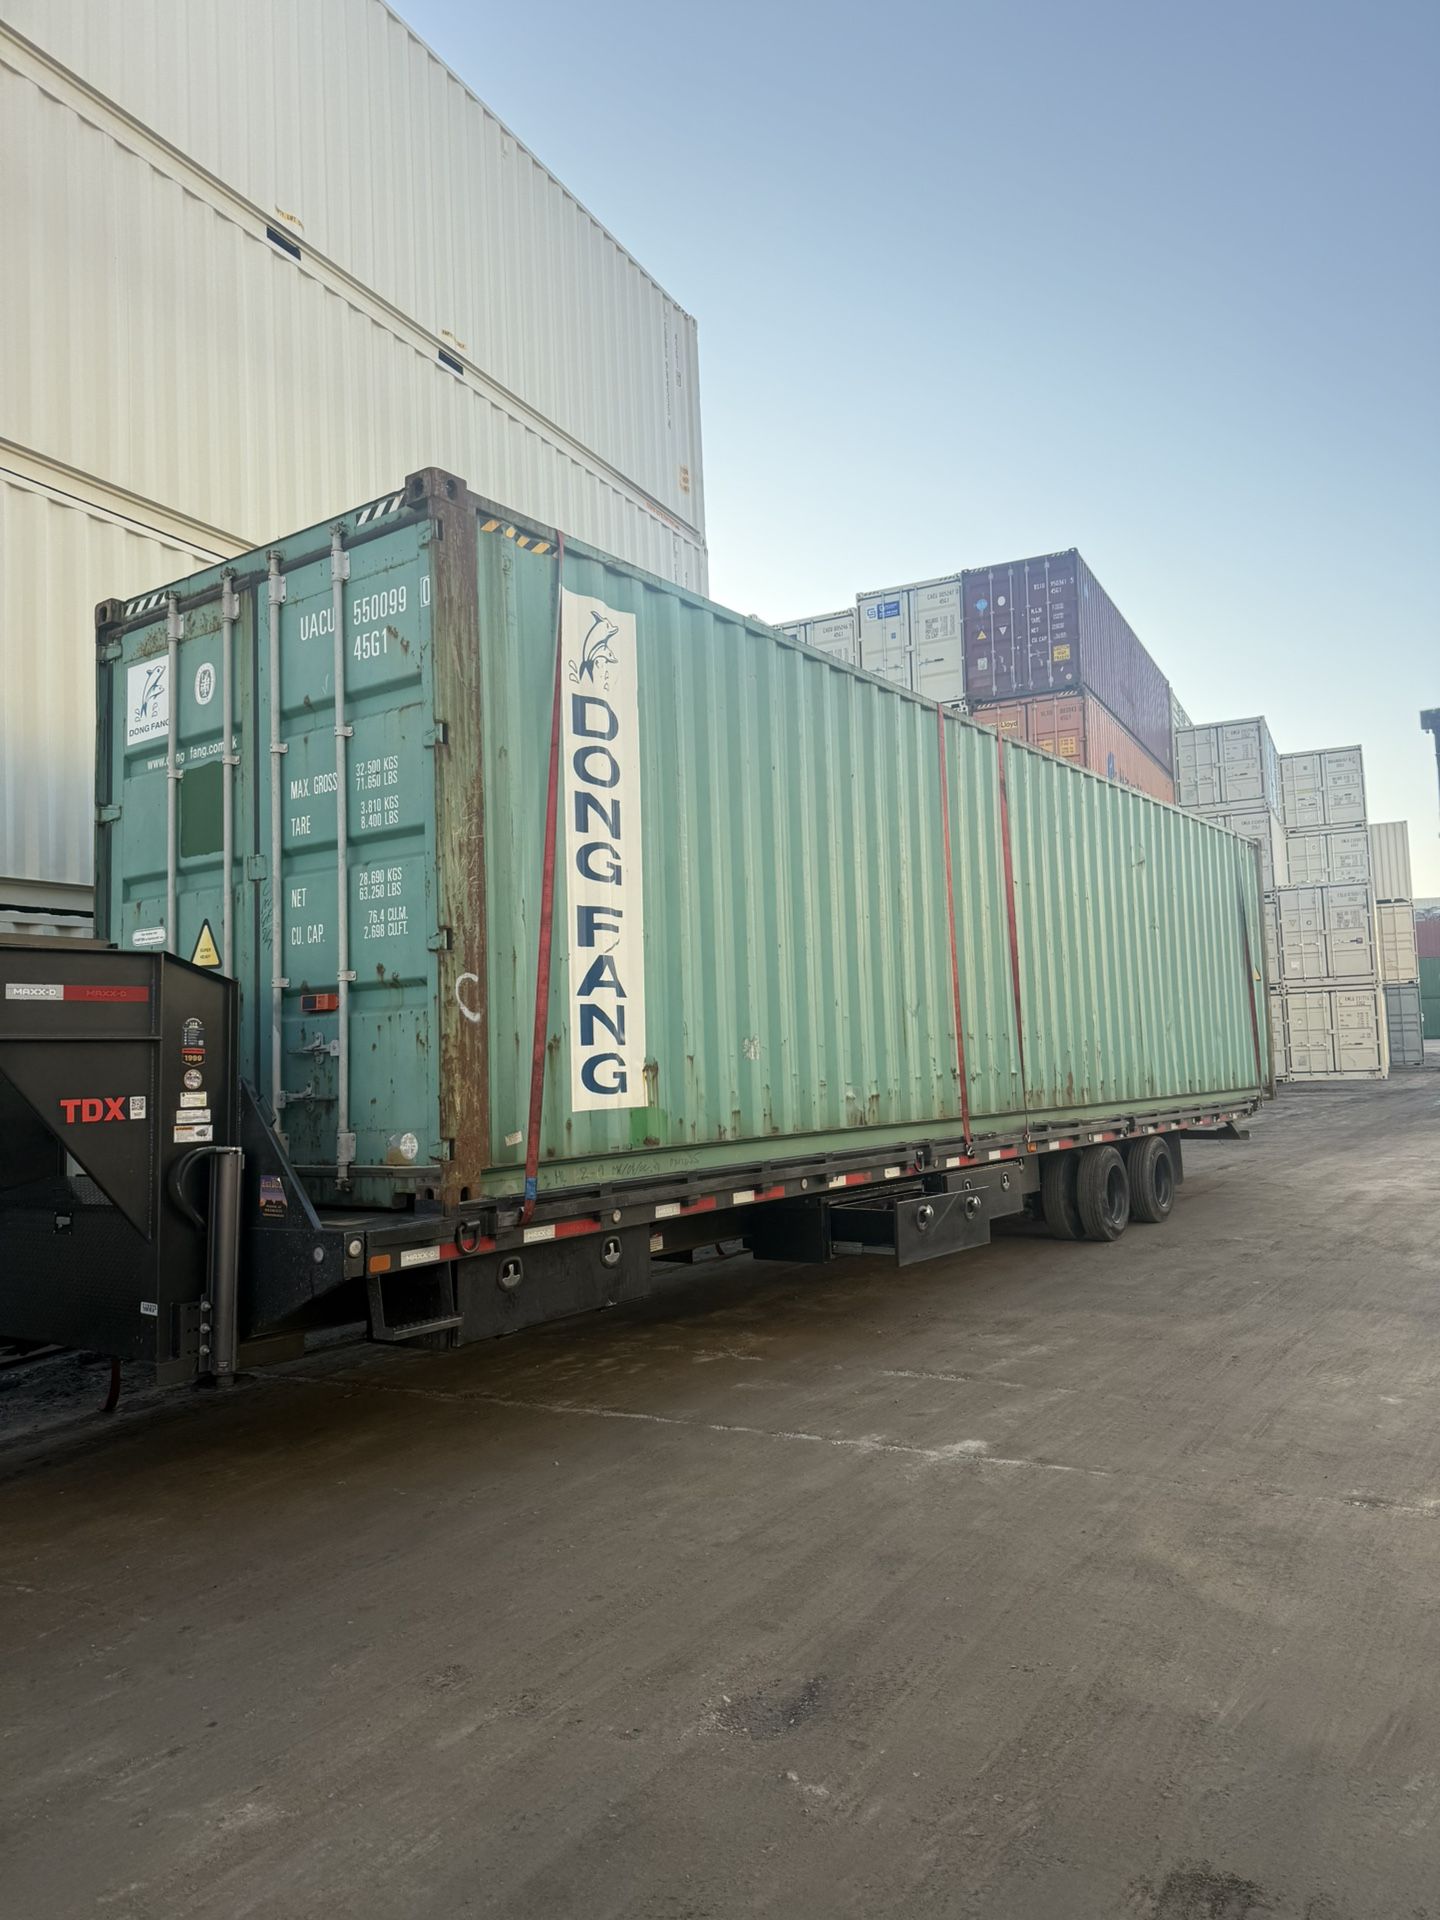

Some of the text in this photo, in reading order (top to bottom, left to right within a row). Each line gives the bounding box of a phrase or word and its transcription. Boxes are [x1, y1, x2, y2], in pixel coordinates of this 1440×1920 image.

[300, 607, 335, 641] UACU
[353, 585, 407, 625] 550099
[353, 627, 387, 661] 45G1
[129, 725, 150, 737] DONG
[355, 755, 398, 777] 32.500 KGS
[290, 772, 338, 800] MAX. GROSS
[355, 770, 398, 791] 71.650 LBS
[360, 795, 399, 815] 3.810 KGS
[291, 815, 311, 837] TARE
[360, 810, 399, 829] 8.400 LBS
[359, 867, 402, 887] 28.690 KGS
[291, 887, 307, 909] NET
[359, 881, 402, 901] 63.250 LBS
[572, 692, 627, 1096] DONG FANG
[368, 909, 384, 924] 76.4
[291, 923, 325, 946] CU. CAP.
[363, 923, 385, 939] 2.698
[60, 1096, 126, 1124] TDX
